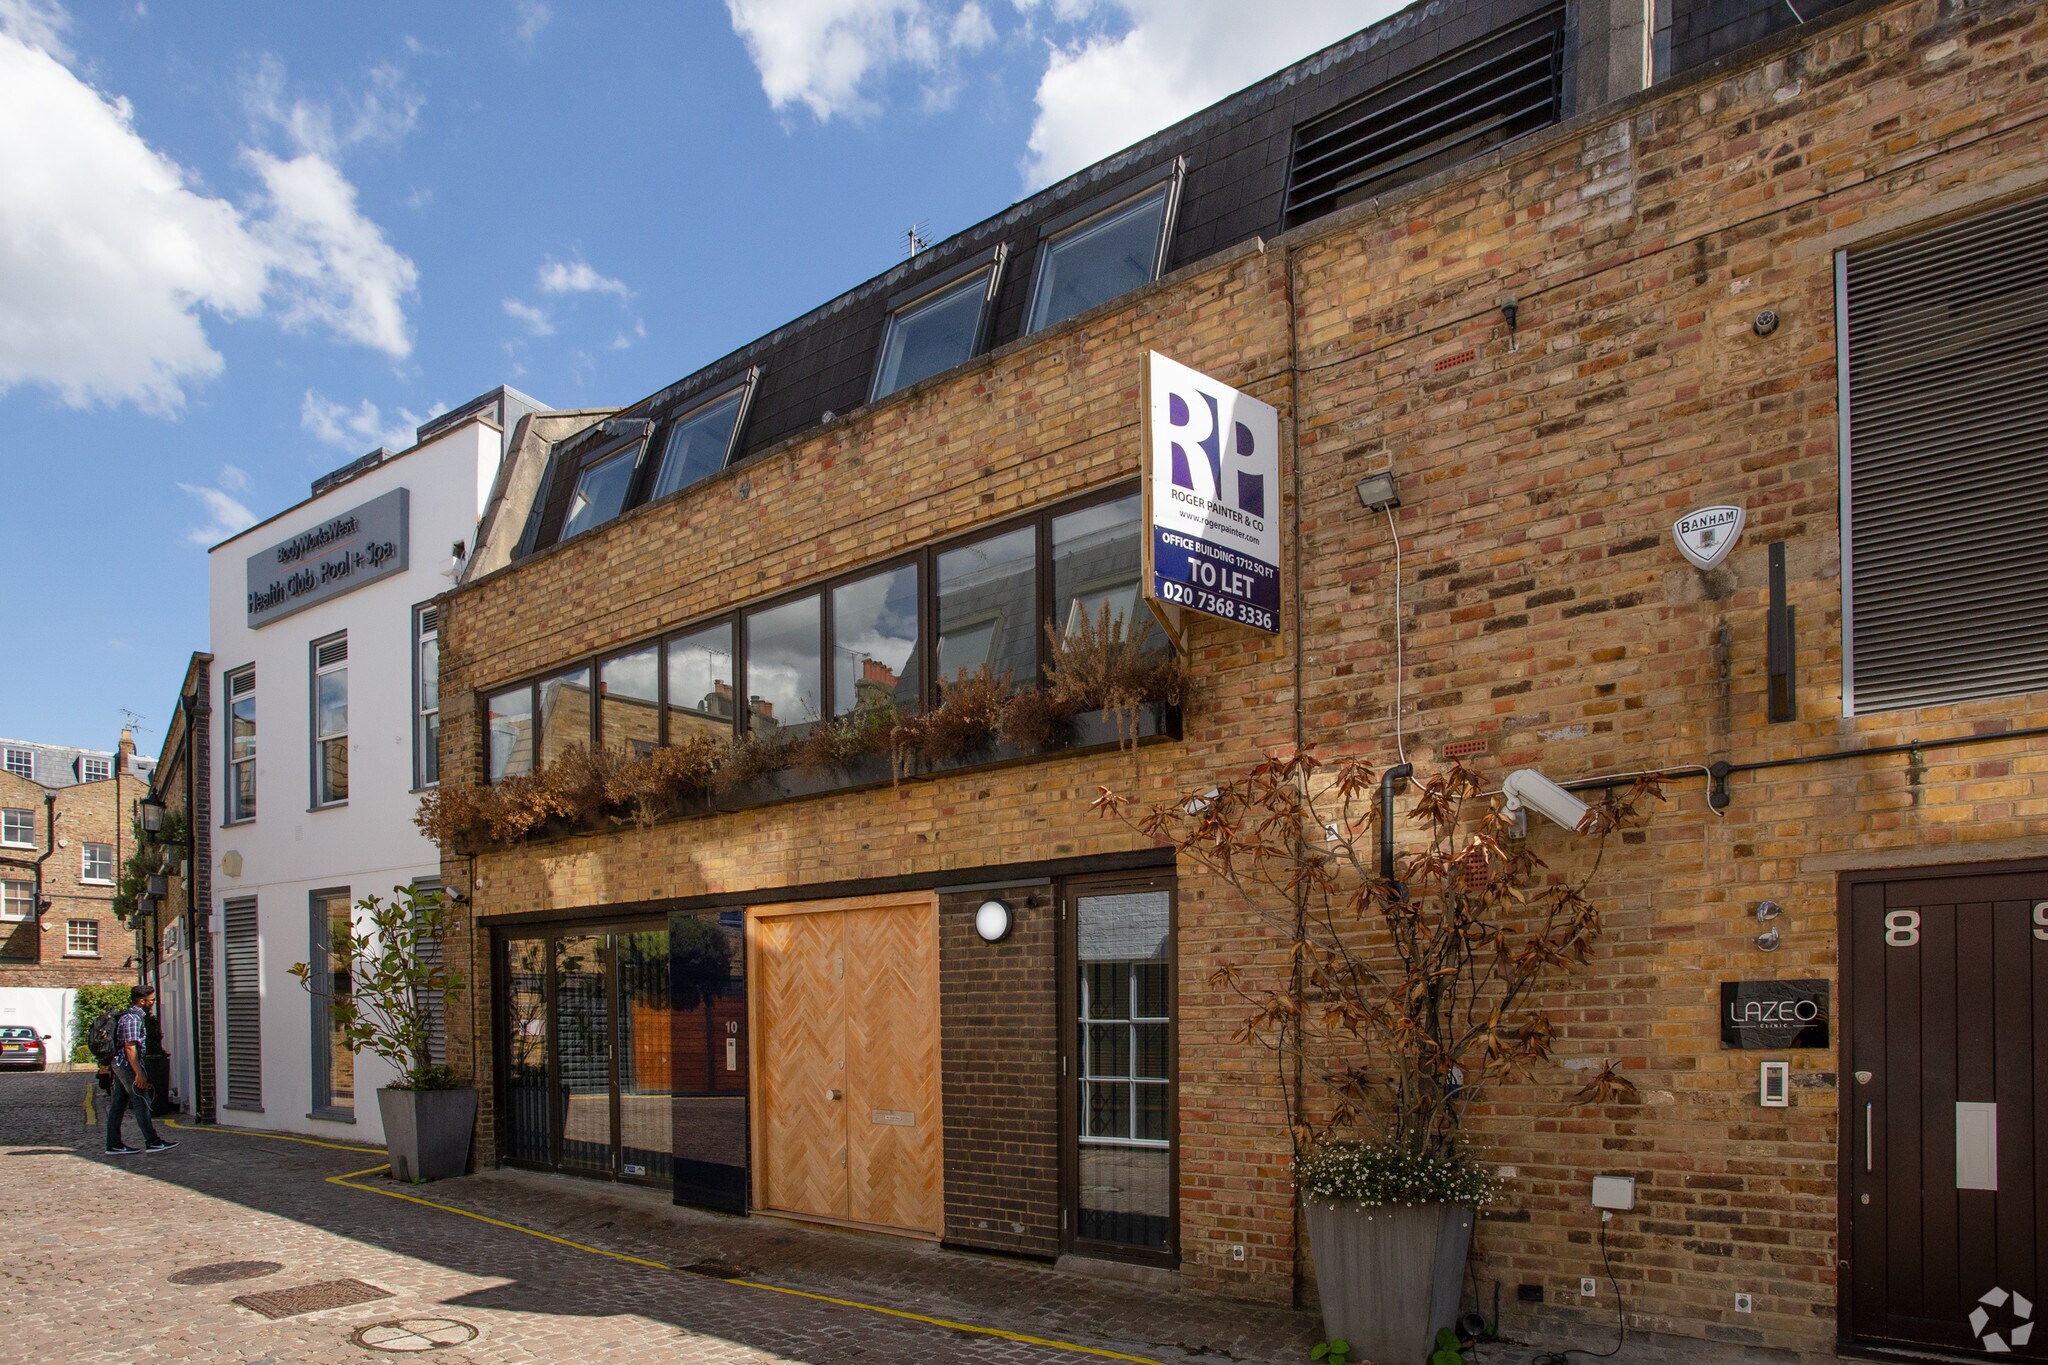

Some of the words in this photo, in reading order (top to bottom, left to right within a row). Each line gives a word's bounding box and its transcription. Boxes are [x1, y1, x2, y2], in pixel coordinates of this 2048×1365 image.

[1171, 488, 1205, 509] ROGER
[1207, 501, 1243, 523] PAINTER
[1244, 515, 1251, 528] &
[1252, 519, 1264, 532] CO
[1179, 510, 1260, 546] www.rogerpainter.com
[1681, 511, 1734, 534] BANHAM
[277, 516, 359, 564] BodyWorksWest
[1162, 532, 1194, 551] OFFICE
[1195, 541, 1235, 564] BUILDING
[1236, 556, 1253, 571] 1712
[1253, 562, 1265, 576] SQ
[1265, 568, 1274, 579] FT
[248, 580, 285, 614] Health
[287, 568, 316, 597] Club
[321, 550, 350, 584] Pool
[366, 540, 395, 569] Spa
[1187, 556, 1216, 587] TO
[1221, 567, 1254, 599] LET
[1163, 581, 1193, 604] 020
[1197, 591, 1234, 617] 7368
[1238, 604, 1272, 629] 3336
[1884, 909, 1921, 947] 8
[725, 1020, 738, 1034] 10
[1730, 1000, 1818, 1022] LAZEO
